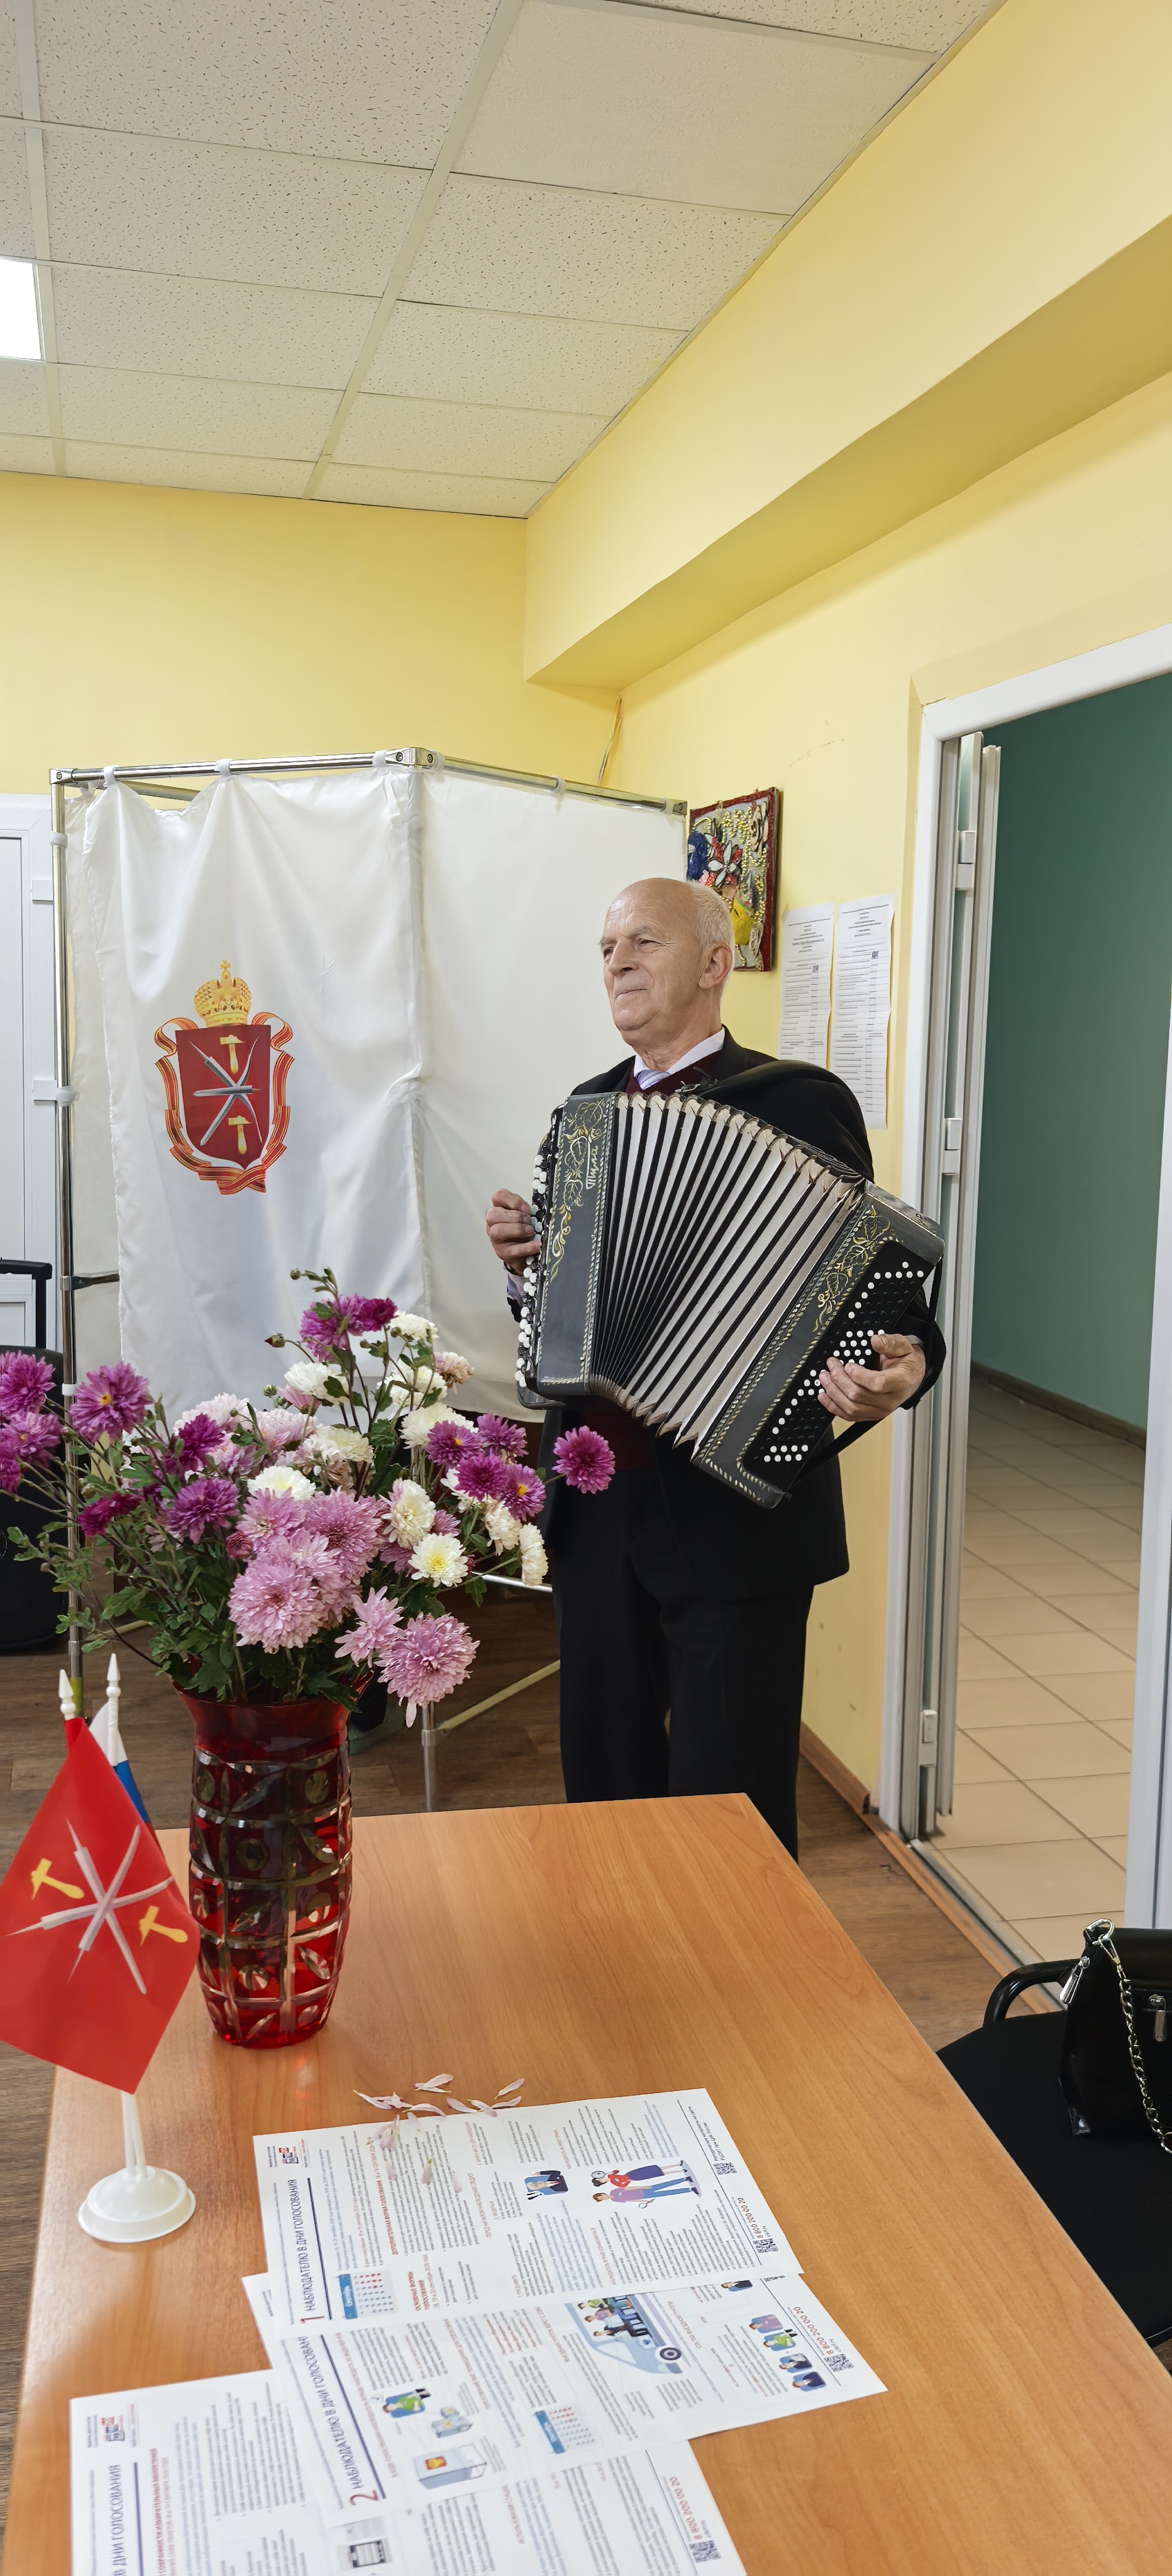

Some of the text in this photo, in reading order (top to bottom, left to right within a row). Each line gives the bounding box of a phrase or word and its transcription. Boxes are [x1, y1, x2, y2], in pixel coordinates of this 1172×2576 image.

[287, 2178, 304, 2229] ГОЛОСОВАНИЯ
[739, 2204, 751, 2212] 00
[744, 2212, 756, 2223] 200
[749, 2223, 761, 2234] 800
[294, 2229, 308, 2246] ДНИ
[296, 2252, 317, 2312] НАБЛЮДАТЕЛЮ
[792, 2306, 804, 2314] 20
[299, 2314, 326, 2324] 1
[799, 2314, 812, 2324] 00
[805, 2324, 821, 2336] 200
[815, 2336, 831, 2350] 800
[316, 2387, 336, 2409] ДНИ
[323, 2407, 338, 2416] В
[326, 2415, 365, 2490] НАБЛЮДАТЕЛЮ
[667, 2476, 681, 2486] 20
[347, 2489, 380, 2507] 2
[672, 2487, 687, 2499] 00
[108, 2464, 124, 2540] ГОЛОСОВАНИЯ
[677, 2500, 693, 2515] 200
[683, 2517, 700, 2533] 800
[111, 2542, 128, 2566] ДНИ
